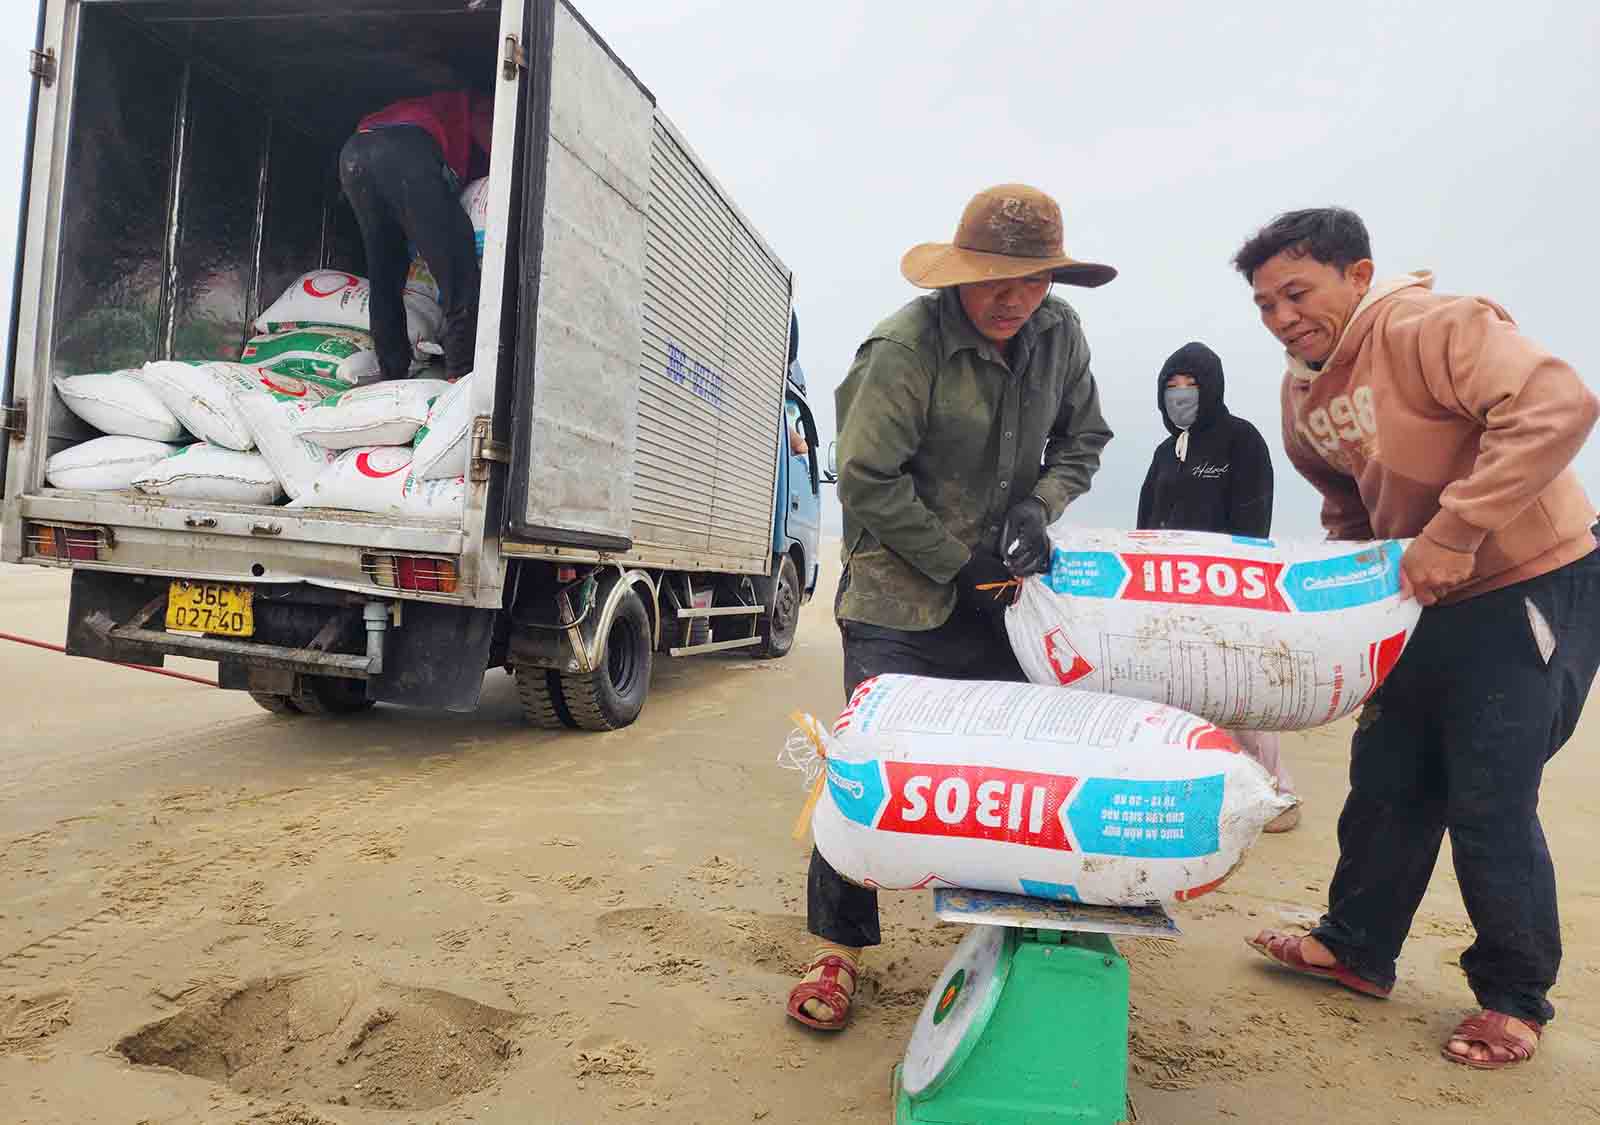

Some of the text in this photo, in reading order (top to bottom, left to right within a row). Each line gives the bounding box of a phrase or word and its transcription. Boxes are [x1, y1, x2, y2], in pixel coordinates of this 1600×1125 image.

[192, 585, 228, 606] 36C
[1143, 559, 1266, 599] 1130S
[902, 775, 1047, 834] 1130S
